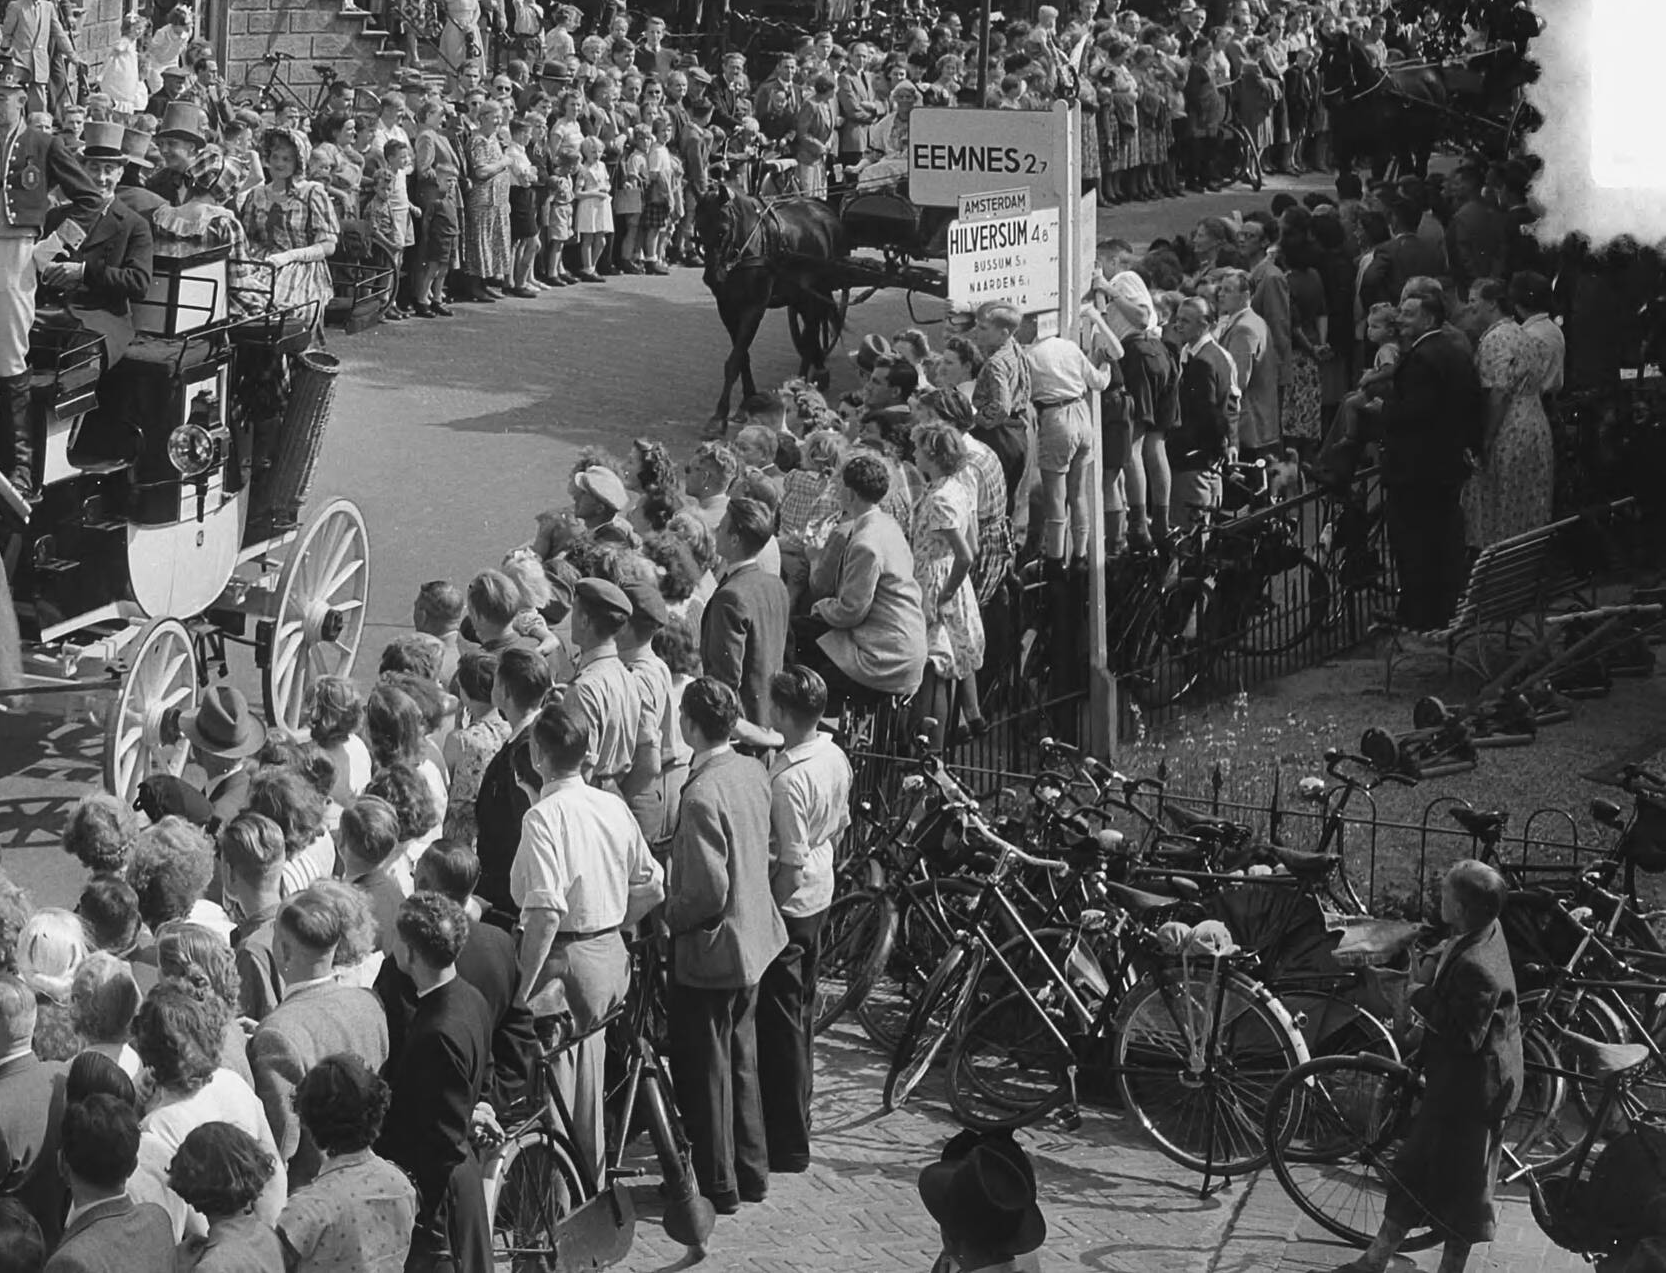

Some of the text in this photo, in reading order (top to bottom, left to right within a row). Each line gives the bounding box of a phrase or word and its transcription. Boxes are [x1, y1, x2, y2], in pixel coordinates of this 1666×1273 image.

[914, 144, 1048, 174] EEMNES 2.7
[964, 194, 1026, 214] AMSTERDAM
[949, 219, 1027, 256] HILVERSUM
[974, 257, 1012, 273] BUSSUM
[969, 276, 1016, 293] NAARDEN
